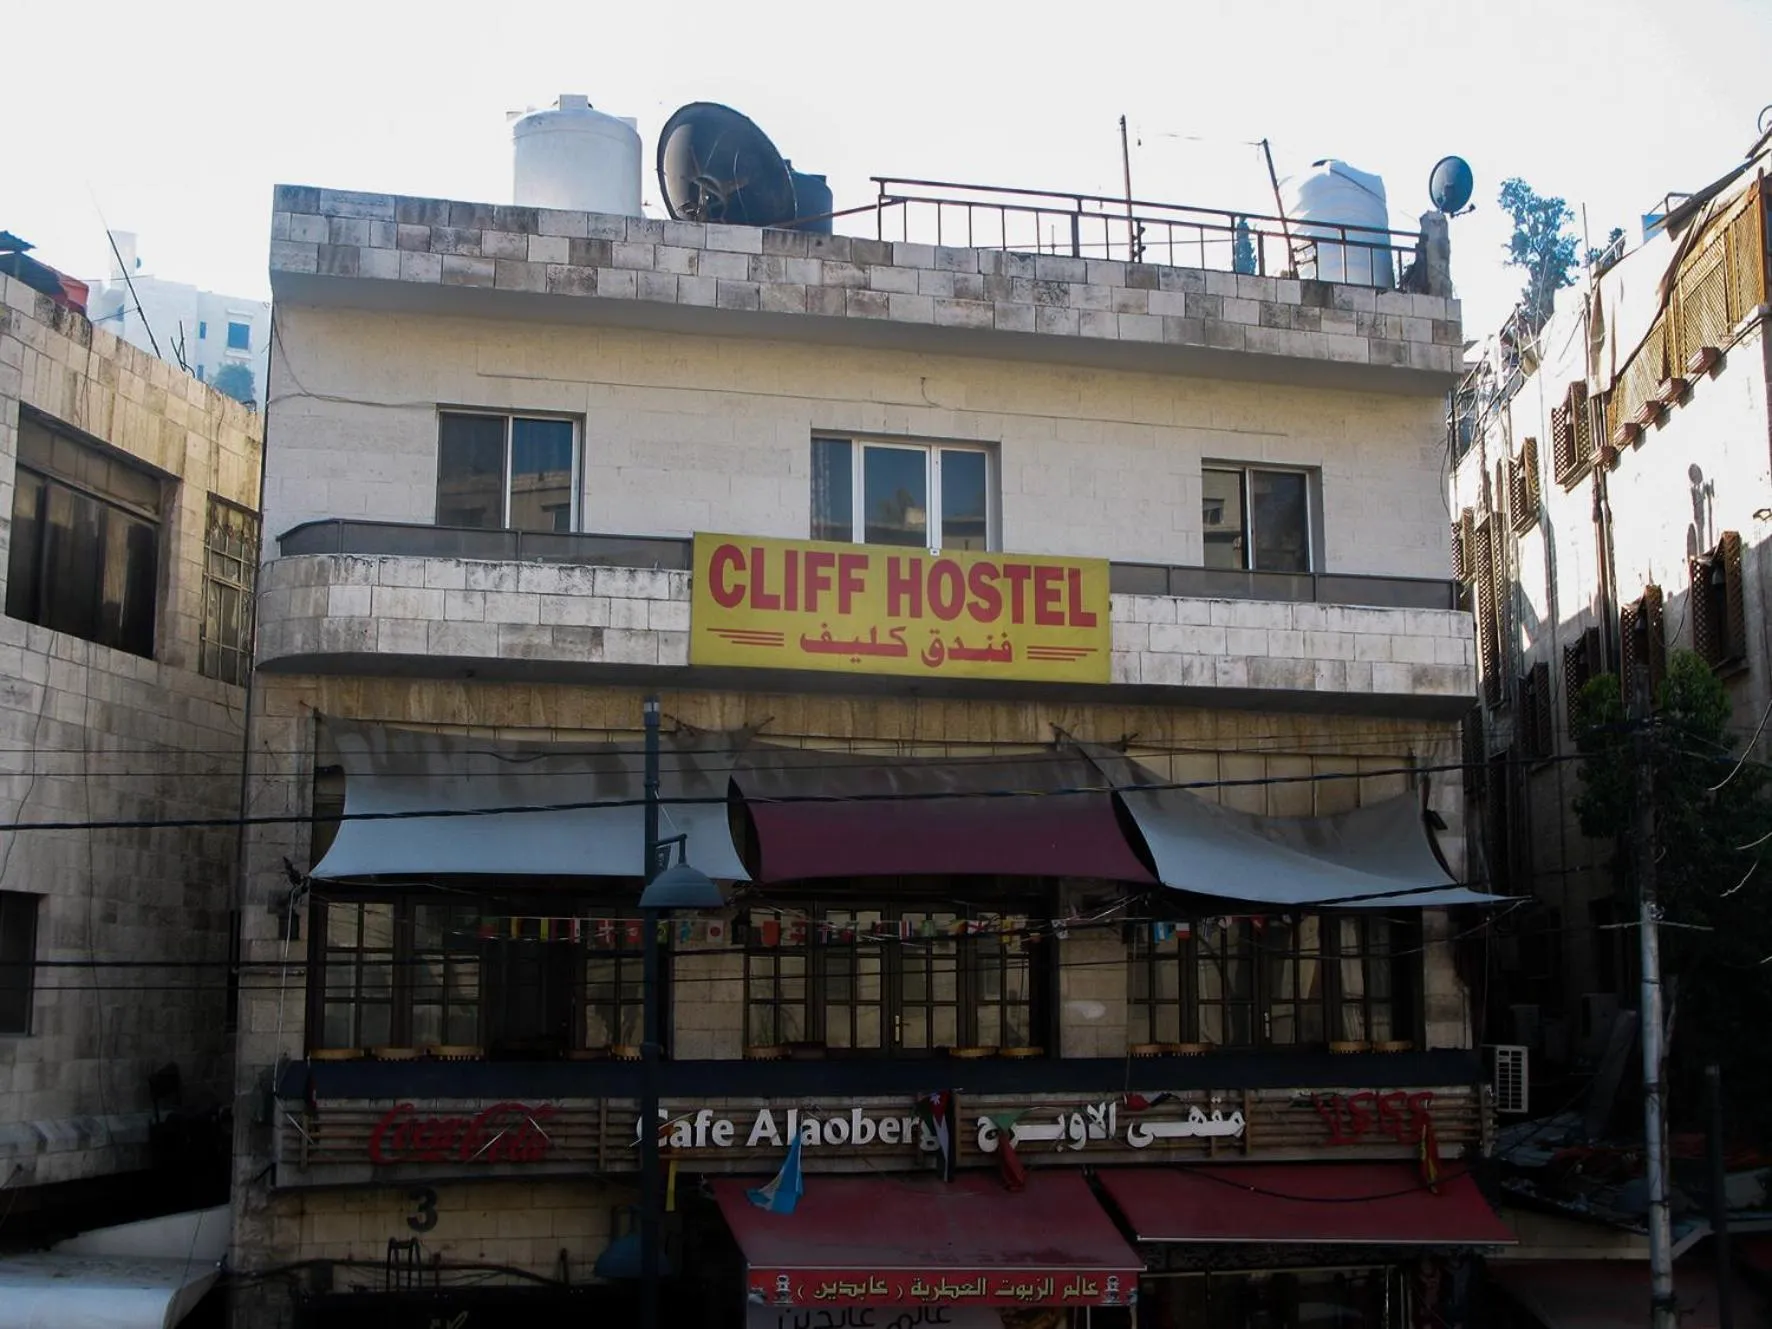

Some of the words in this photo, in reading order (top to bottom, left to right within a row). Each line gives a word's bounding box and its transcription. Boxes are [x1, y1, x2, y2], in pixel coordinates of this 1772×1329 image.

[708, 543, 870, 615] CLIFF
[887, 556, 1098, 628] HOSTEL
[799, 622, 909, 664] كليف
[921, 628, 1014, 668] فندق
[745, 1107, 943, 1152] Alaoberg
[407, 1189, 438, 1233] 3
[1062, 1275, 1099, 1301] عالم
